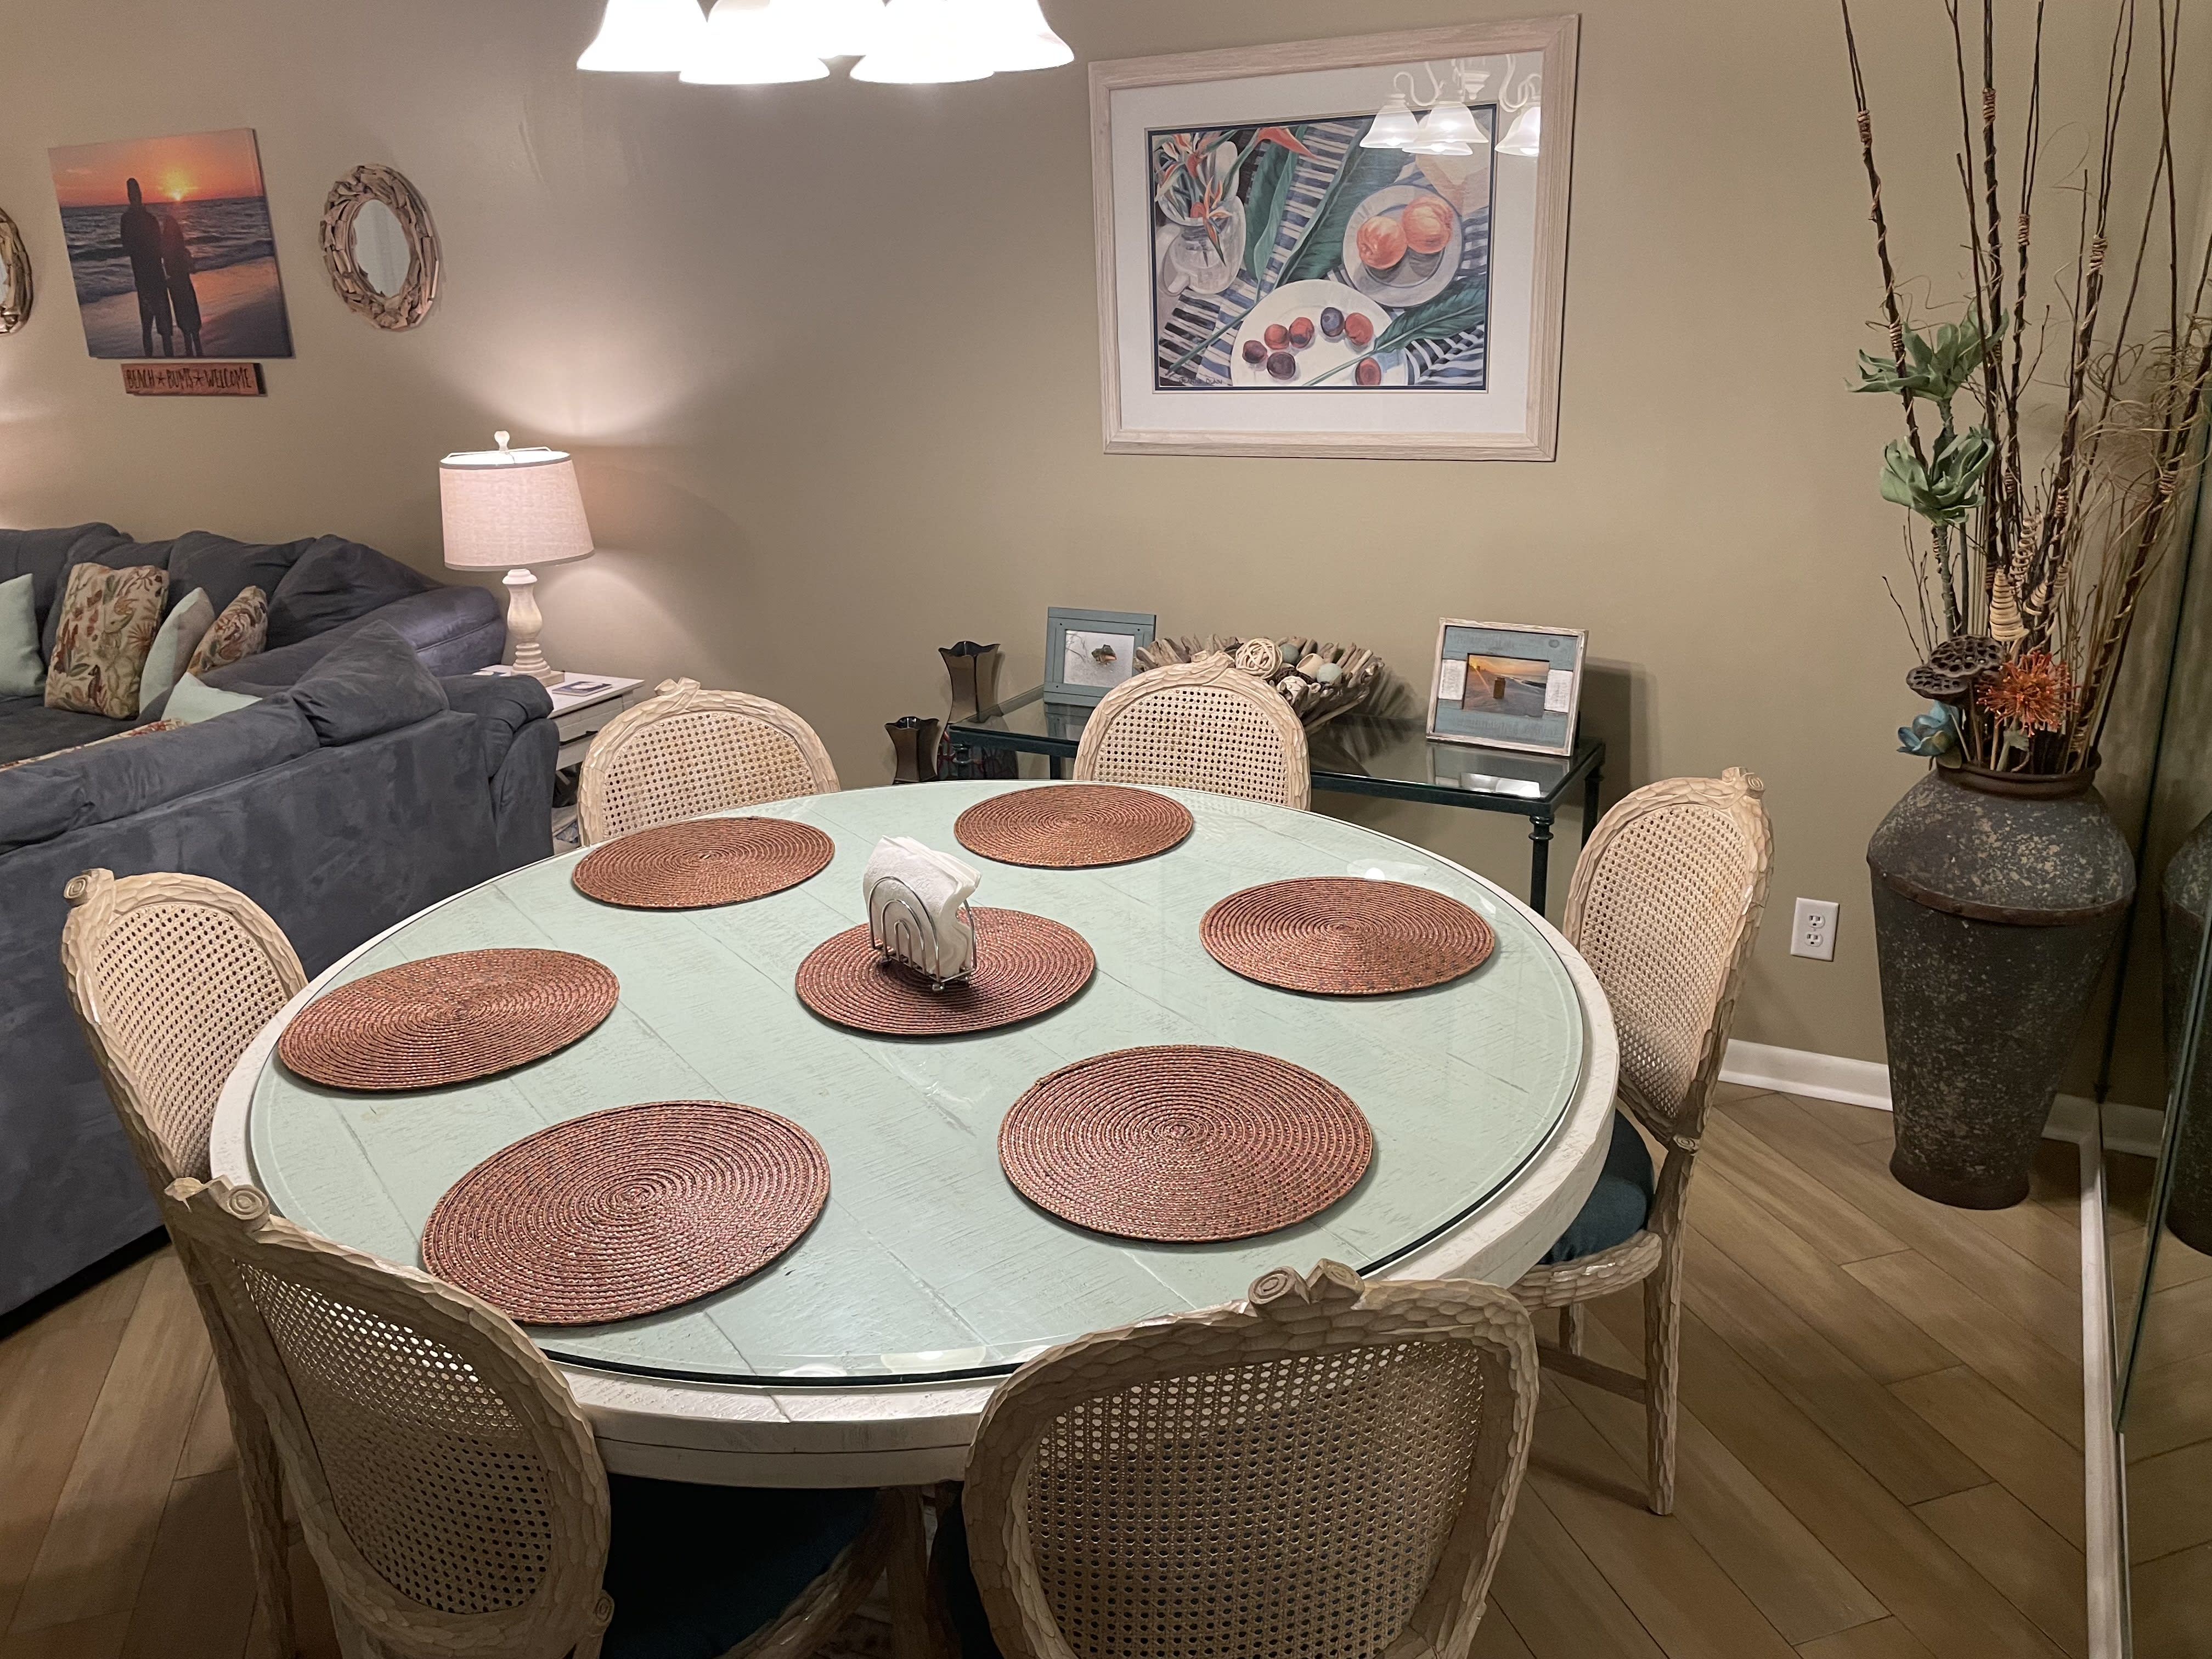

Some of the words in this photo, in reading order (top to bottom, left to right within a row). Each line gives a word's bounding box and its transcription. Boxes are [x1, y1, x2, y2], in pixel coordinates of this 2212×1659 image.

[126, 369, 155, 389] BEACH
[166, 368, 194, 390] BUMS
[203, 366, 252, 389] WELCOME
